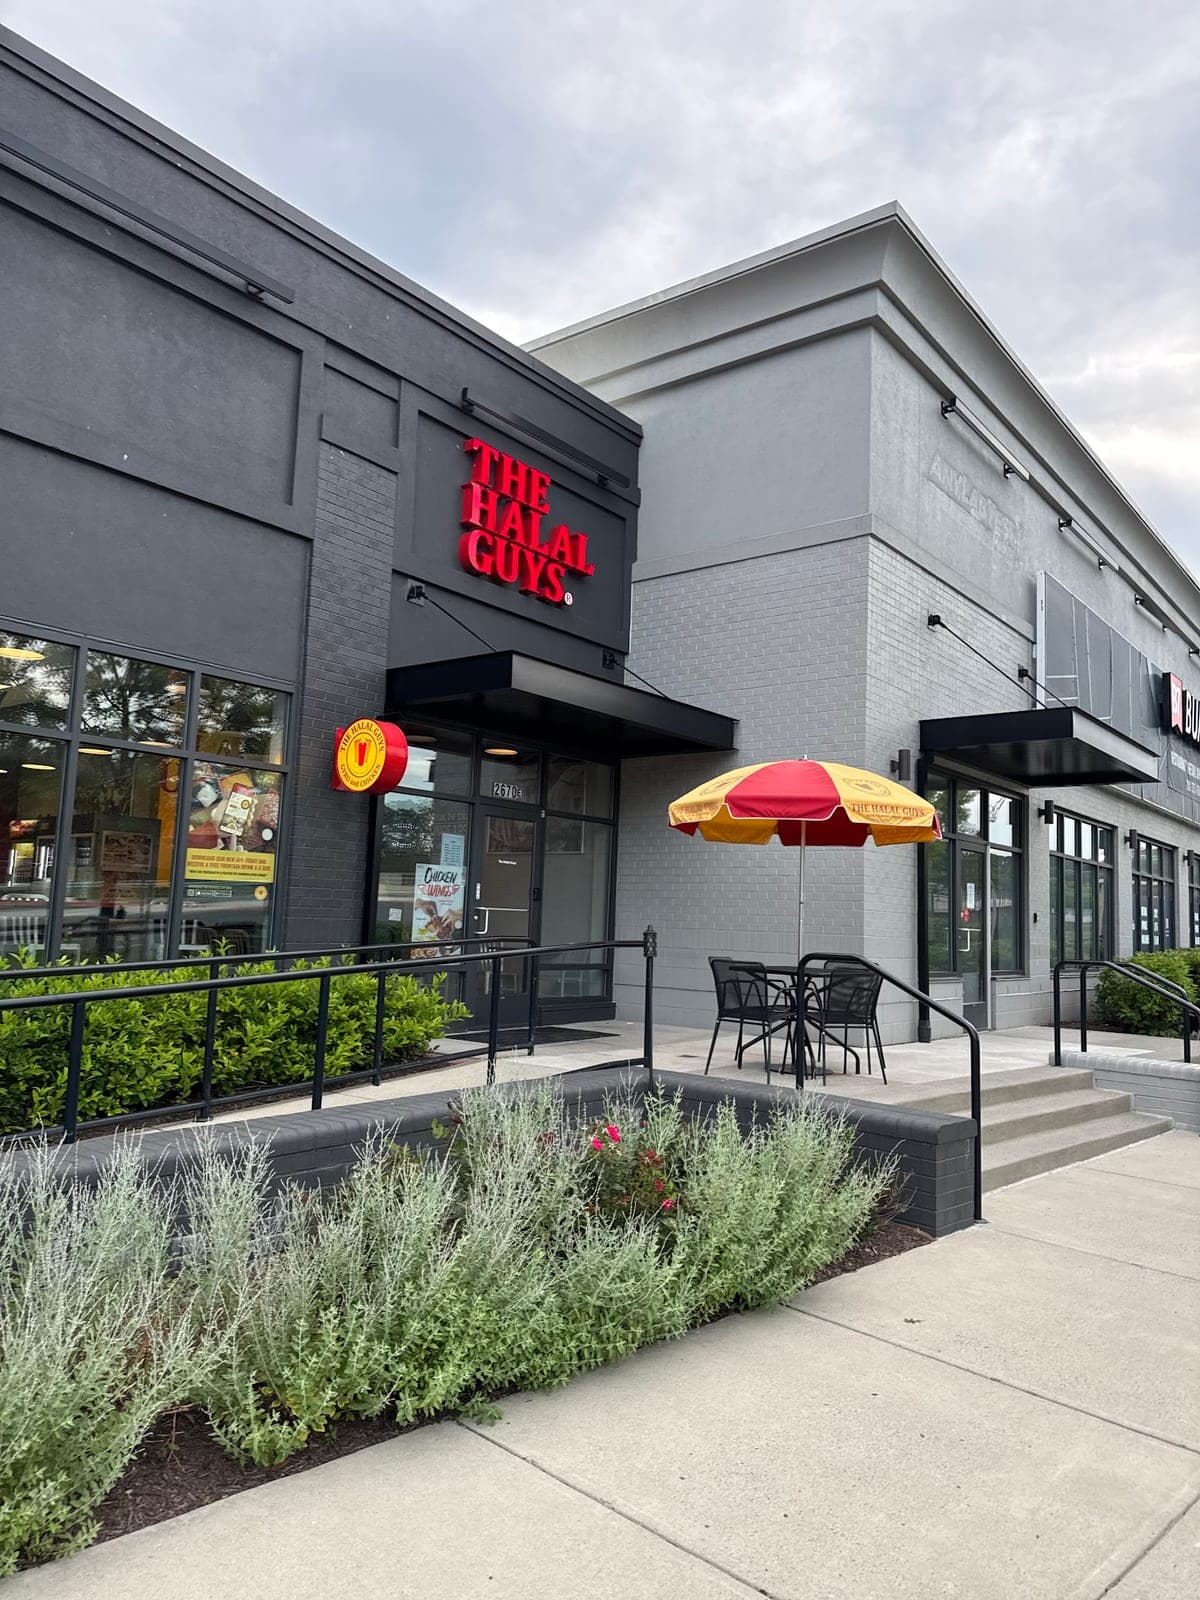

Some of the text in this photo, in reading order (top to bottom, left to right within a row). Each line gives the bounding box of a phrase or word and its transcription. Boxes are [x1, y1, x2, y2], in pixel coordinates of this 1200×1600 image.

[464, 437, 551, 515] THE
[461, 481, 595, 577] HALAL
[459, 529, 567, 604] GUYS
[340, 722, 385, 752] THE HALAL GUYS
[852, 803, 871, 814] THE
[872, 804, 901, 815] HALAL
[902, 807, 926, 817] GUYS
[424, 867, 457, 884] CHICKEN
[426, 884, 452, 897] WINGS
